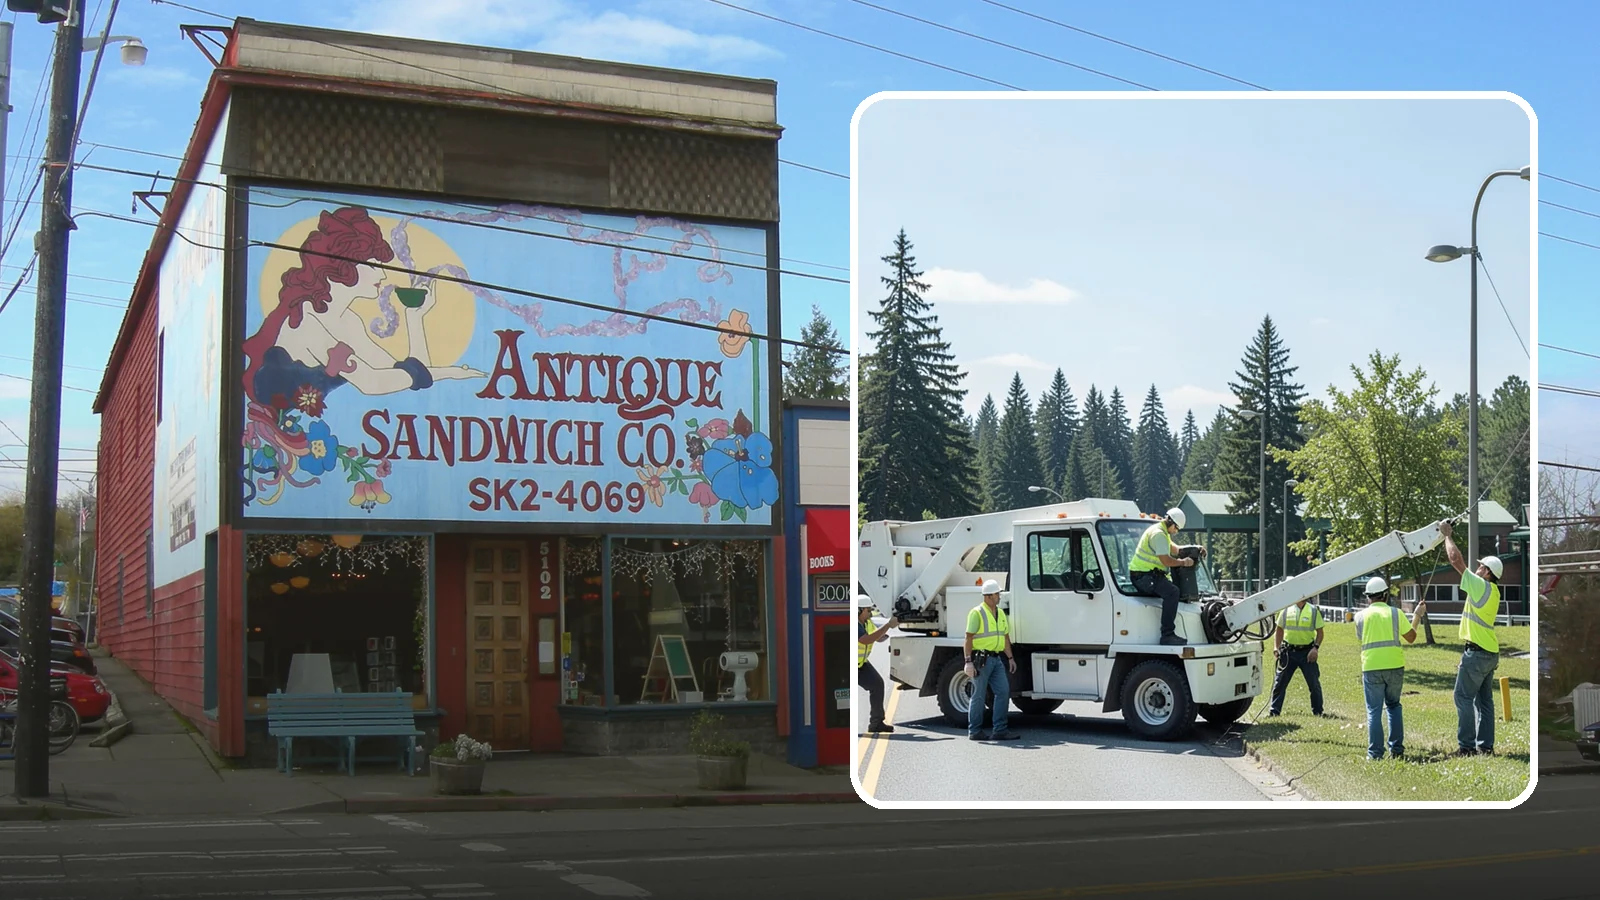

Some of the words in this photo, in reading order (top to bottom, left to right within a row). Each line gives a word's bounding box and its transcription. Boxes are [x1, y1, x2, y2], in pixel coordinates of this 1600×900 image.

[477, 330, 722, 420] ANTIQUE
[361, 409, 604, 467] SANDWICH
[617, 422, 685, 469] CO.
[469, 478, 646, 512] SK2-4069
[540, 541, 551, 600] 5102
[809, 555, 835, 569] BOOKS
